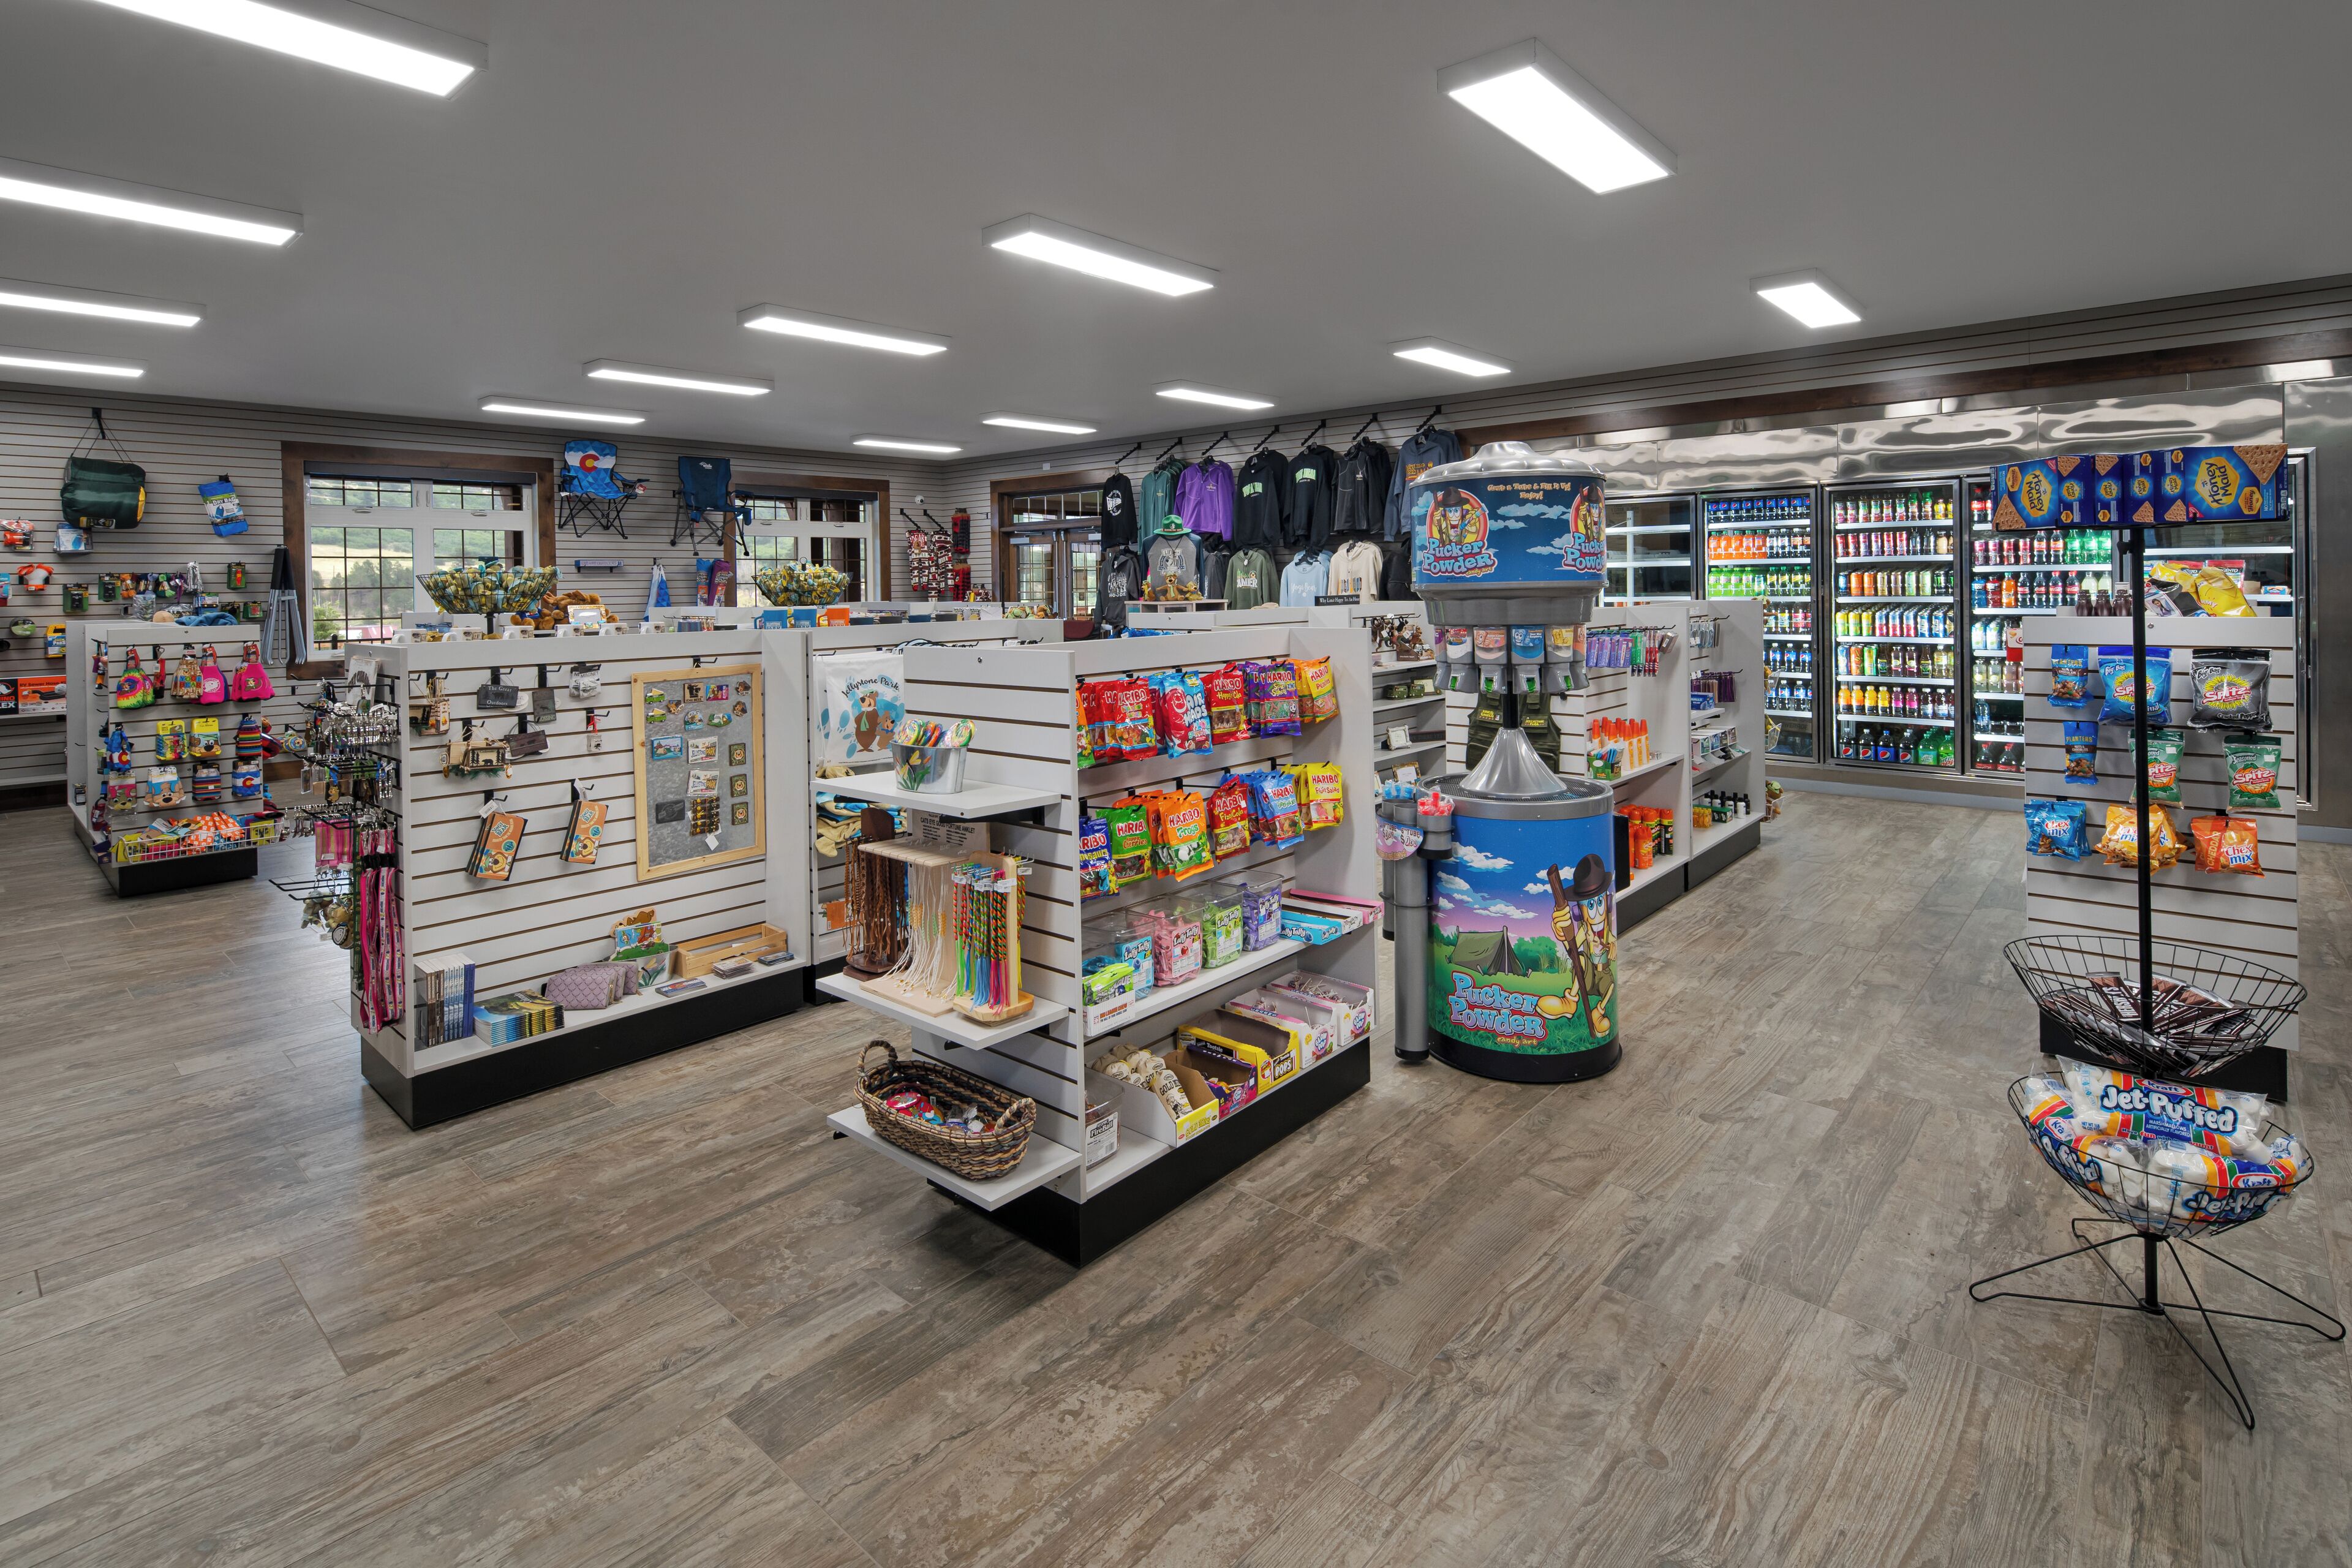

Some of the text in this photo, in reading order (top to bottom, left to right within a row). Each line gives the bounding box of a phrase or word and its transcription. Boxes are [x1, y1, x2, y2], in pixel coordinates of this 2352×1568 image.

[1428, 538, 1484, 558] Pucker
[2105, 665, 2114, 676] Big
[2196, 668, 2208, 679] Big
[1267, 671, 1292, 684] HARIBO
[840, 676, 900, 698] Jellystone Park
[1213, 678, 1242, 691] HARIBO
[1185, 692, 1205, 708] AIR
[2130, 703, 2161, 712] Oinal
[2232, 754, 2257, 764] Seasoned
[2148, 763, 2176, 778] pitz
[2233, 769, 2276, 785] Spitz
[1312, 774, 1339, 785] HARIBO
[1168, 807, 1200, 827] HARIBO
[2114, 814, 2128, 823] NUT
[946, 823, 962, 831] FORTUNE
[961, 825, 976, 834] ANKLET
[1175, 823, 1199, 839] Frogs
[1122, 838, 1148, 850] Cherries
[2207, 831, 2221, 867] CHEDDAR
[2225, 843, 2253, 856] Chex
[1079, 848, 1109, 861] nosaurs
[2230, 852, 2253, 865] mix
[1217, 909, 1240, 927] Laffy Taffy
[1173, 925, 1199, 947] Laffy Taffy
[1292, 927, 1306, 938] Taffy
[1123, 940, 1152, 961] Laffy Taffy
[1451, 973, 1539, 1014] Pucker
[1206, 1042, 1223, 1052] Tootsie
[1497, 1036, 1520, 1046] candy
[1275, 1058, 1293, 1079] POPS
[1159, 1081, 1175, 1096] GOLD
[2147, 1079, 2180, 1093] Kraft
[2103, 1085, 2234, 1132] Jet-Puffed
[2146, 1123, 2191, 1138] ARTIFICIALLY FLAVORED
[2149, 1119, 2187, 1132] MARSHMALLOWS
[2242, 1178, 2272, 1188] Kraft
